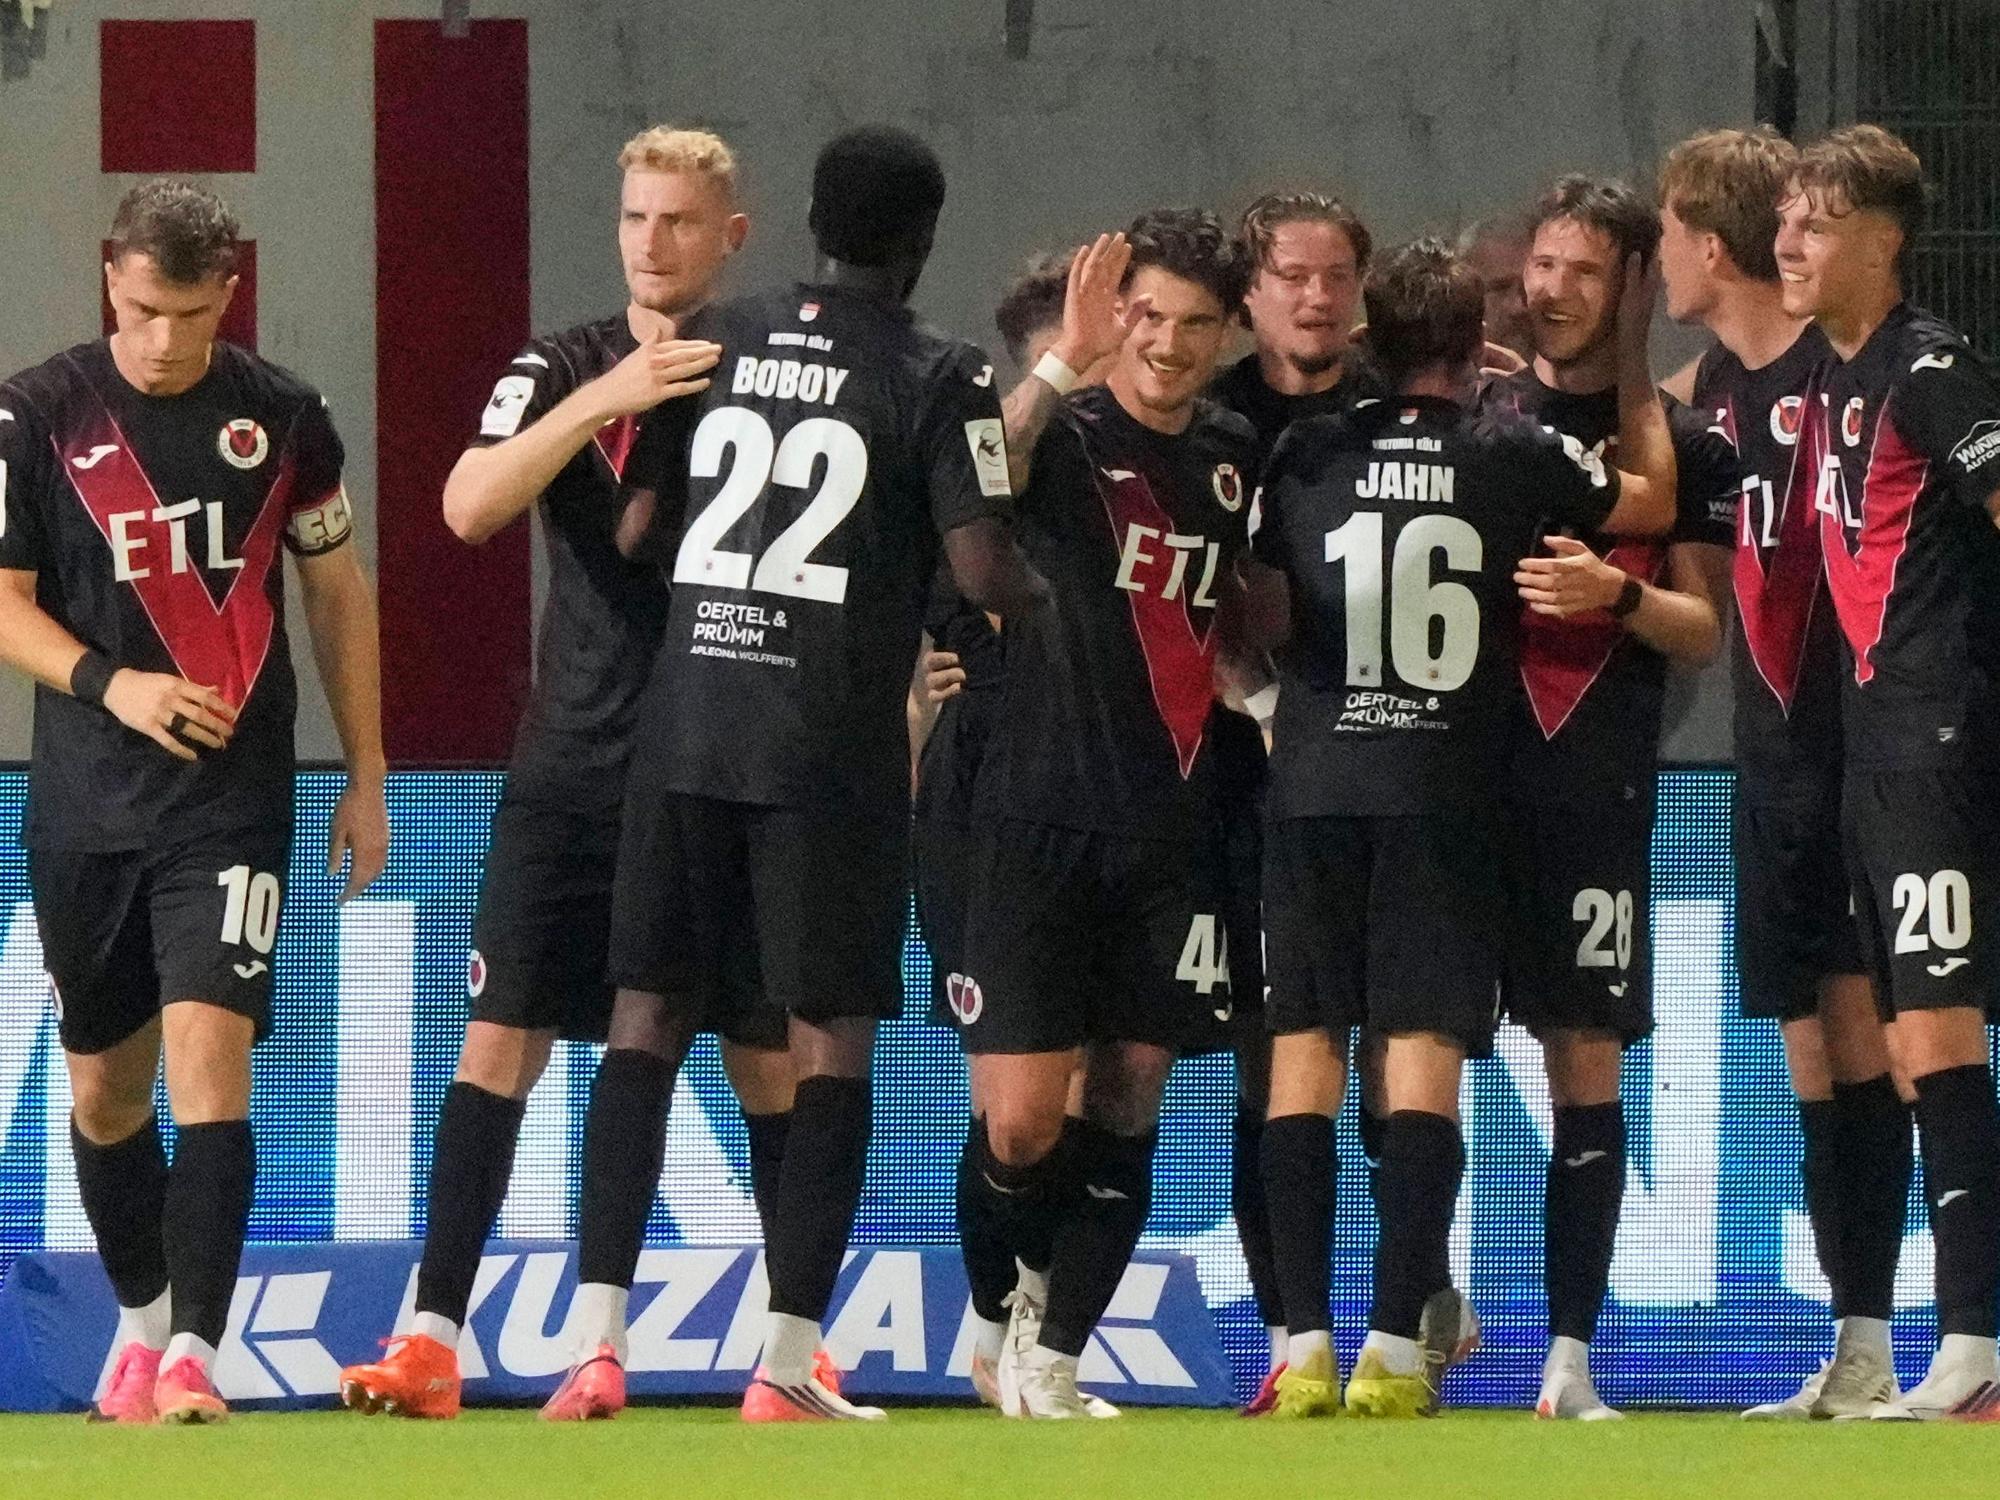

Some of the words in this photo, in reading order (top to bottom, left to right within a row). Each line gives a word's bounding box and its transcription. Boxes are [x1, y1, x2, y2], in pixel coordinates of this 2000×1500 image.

[732, 356, 850, 406] BOBOY
[672, 406, 868, 604] 22
[1355, 461, 1454, 503] JAHN
[1741, 473, 1780, 548] TL
[108, 497, 245, 582] ETL
[1114, 522, 1220, 608] ETL
[693, 621, 765, 647] PRÜMM
[697, 600, 770, 626] OERTEL
[772, 610, 788, 628] &
[1324, 511, 1483, 692] 16
[1346, 691, 1423, 710] OERTEL
[1426, 696, 1440, 711] &
[217, 864, 280, 955] 10
[1572, 887, 1633, 970] 28
[1892, 868, 1972, 955] 20
